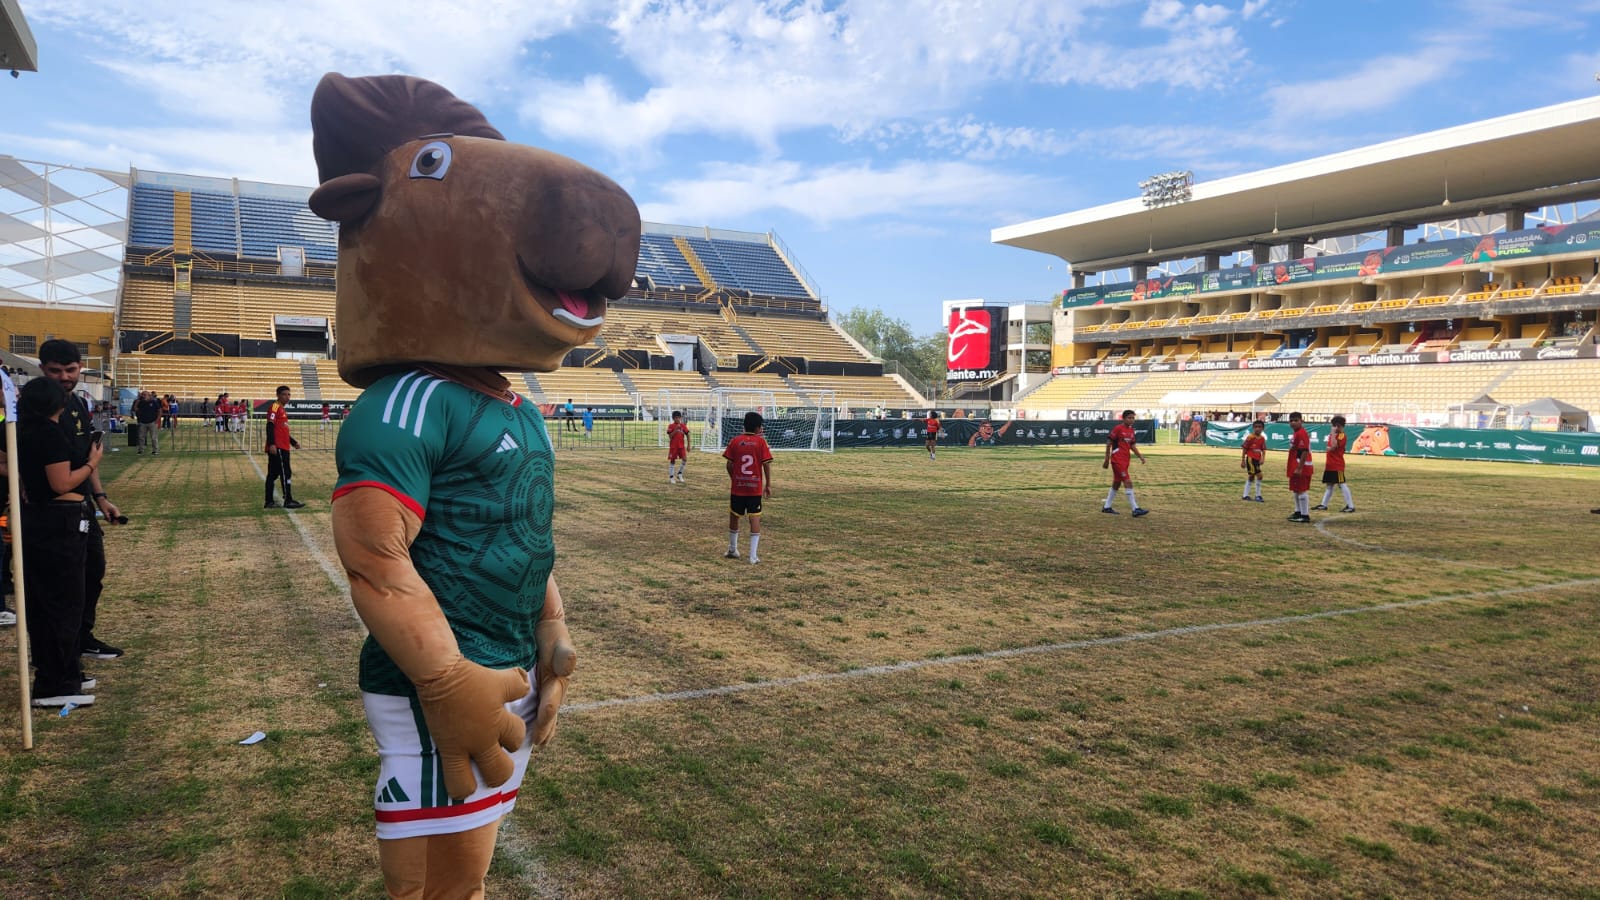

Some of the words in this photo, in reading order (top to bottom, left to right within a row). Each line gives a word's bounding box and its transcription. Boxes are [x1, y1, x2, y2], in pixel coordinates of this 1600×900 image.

[1358, 353, 1420, 365] caliente.mx
[1450, 349, 1521, 361] caliente.mx
[1104, 364, 1141, 373] caliente.mx
[1185, 360, 1230, 370] caliente.mx
[1248, 358, 1298, 368] caliente.mx
[741, 454, 754, 475] 2
